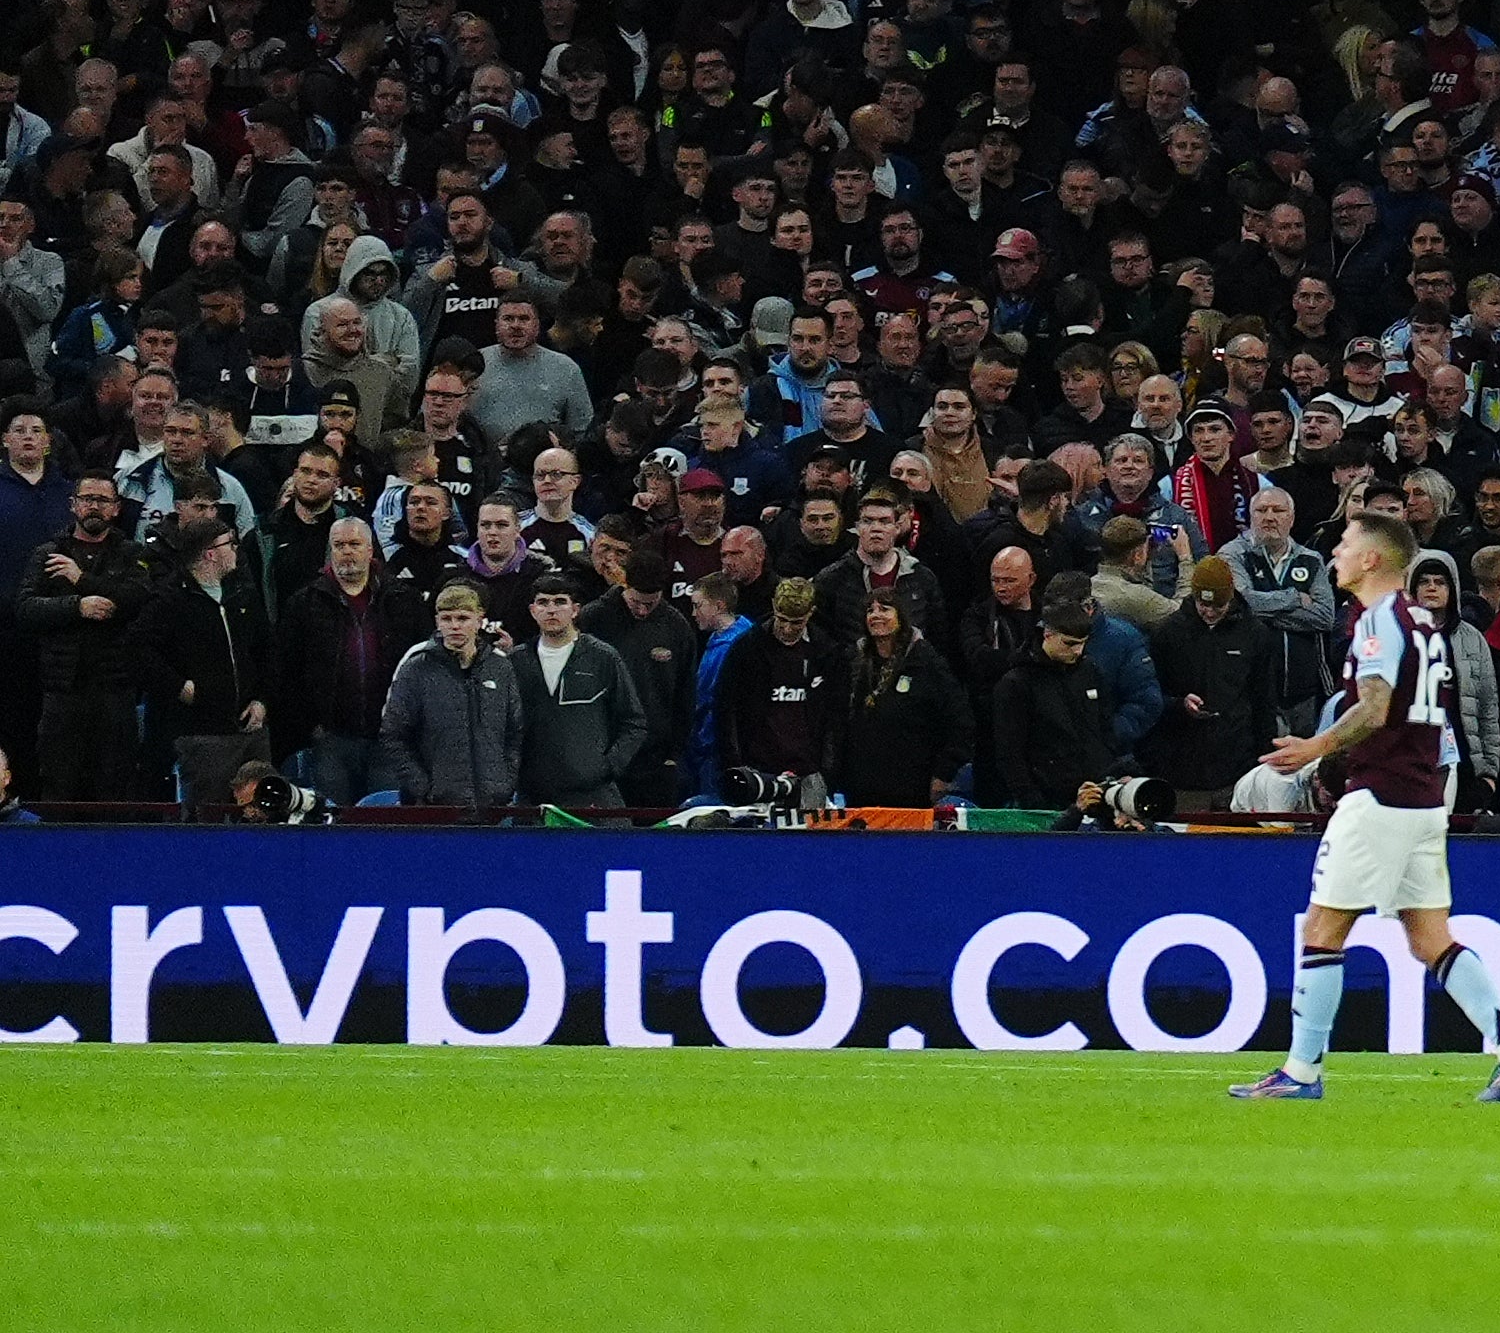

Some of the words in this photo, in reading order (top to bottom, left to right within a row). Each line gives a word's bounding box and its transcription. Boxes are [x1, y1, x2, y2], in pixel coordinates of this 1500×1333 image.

[444, 296, 500, 315] Betan
[1408, 629, 1453, 725] 12
[771, 685, 808, 702] etan
